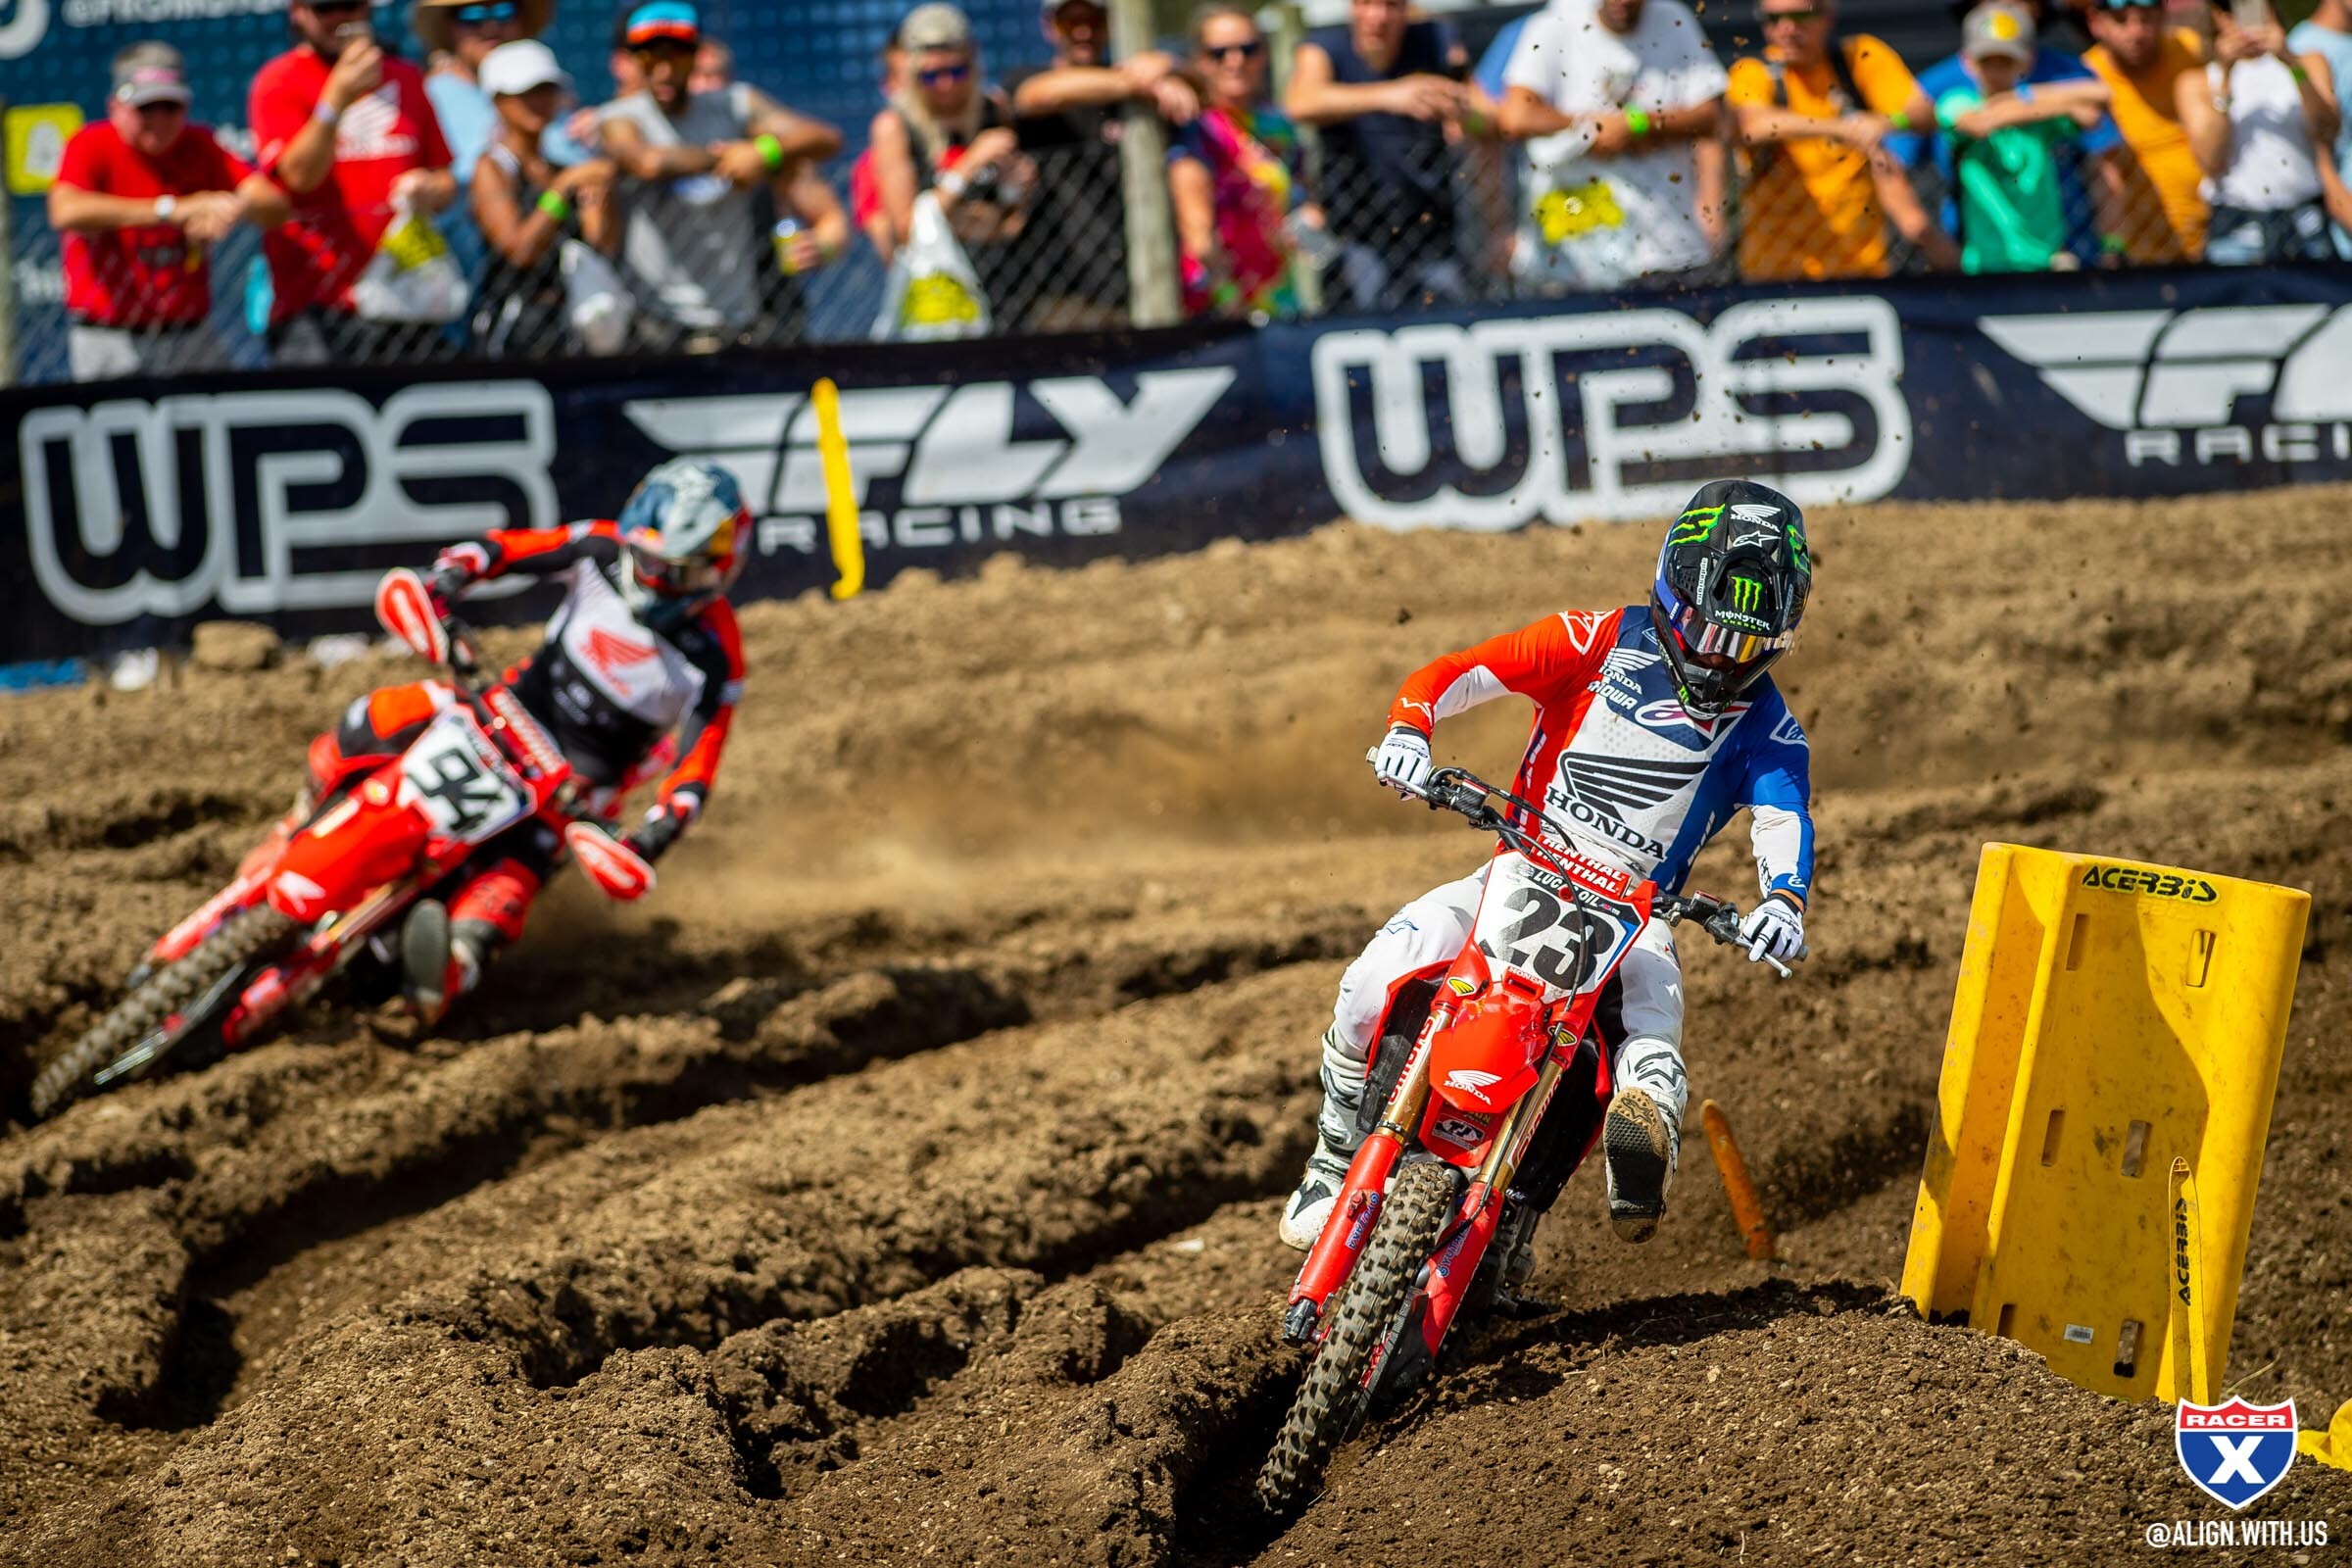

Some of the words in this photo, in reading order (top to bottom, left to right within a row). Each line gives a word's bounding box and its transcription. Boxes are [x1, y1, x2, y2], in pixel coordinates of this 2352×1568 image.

[1311, 295, 1913, 530] WPS
[622, 365, 1237, 513] FLY
[21, 378, 560, 624] WPS
[758, 496, 1122, 556] RACING
[1730, 514, 1781, 532] HONDA
[1715, 610, 1770, 630] MONSTER
[1723, 618, 1762, 631] ENERGY
[1545, 786, 1664, 859] HONDA
[1542, 838, 1624, 881] RENTHAL
[2082, 865, 2217, 902] ACERBIS
[1534, 871, 1579, 894] LUC
[1579, 891, 1599, 907] OIL
[1479, 887, 1615, 990] 23
[1444, 1080, 1492, 1105] HONDA
[2176, 1198, 2191, 1306] ACERBIS
